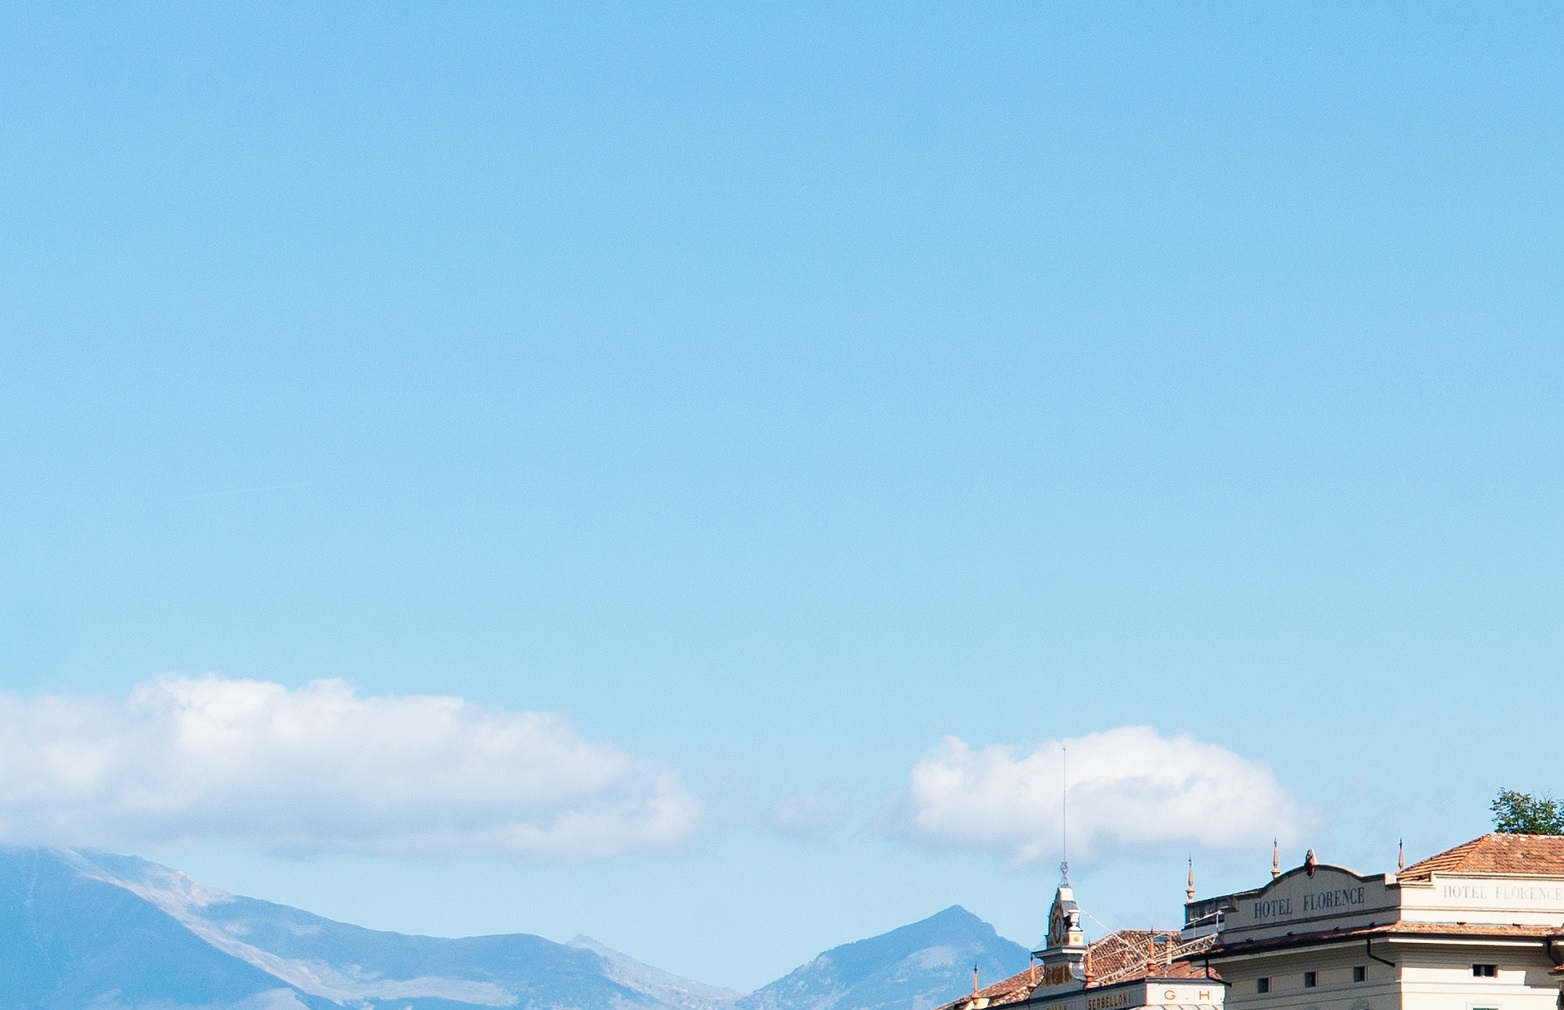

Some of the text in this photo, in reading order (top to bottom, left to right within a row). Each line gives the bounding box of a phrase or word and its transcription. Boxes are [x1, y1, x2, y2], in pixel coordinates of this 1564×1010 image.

[1253, 887, 1365, 919] HOTEL FLORENCE
[1443, 885, 1563, 901] HOTEL FLORENCE
